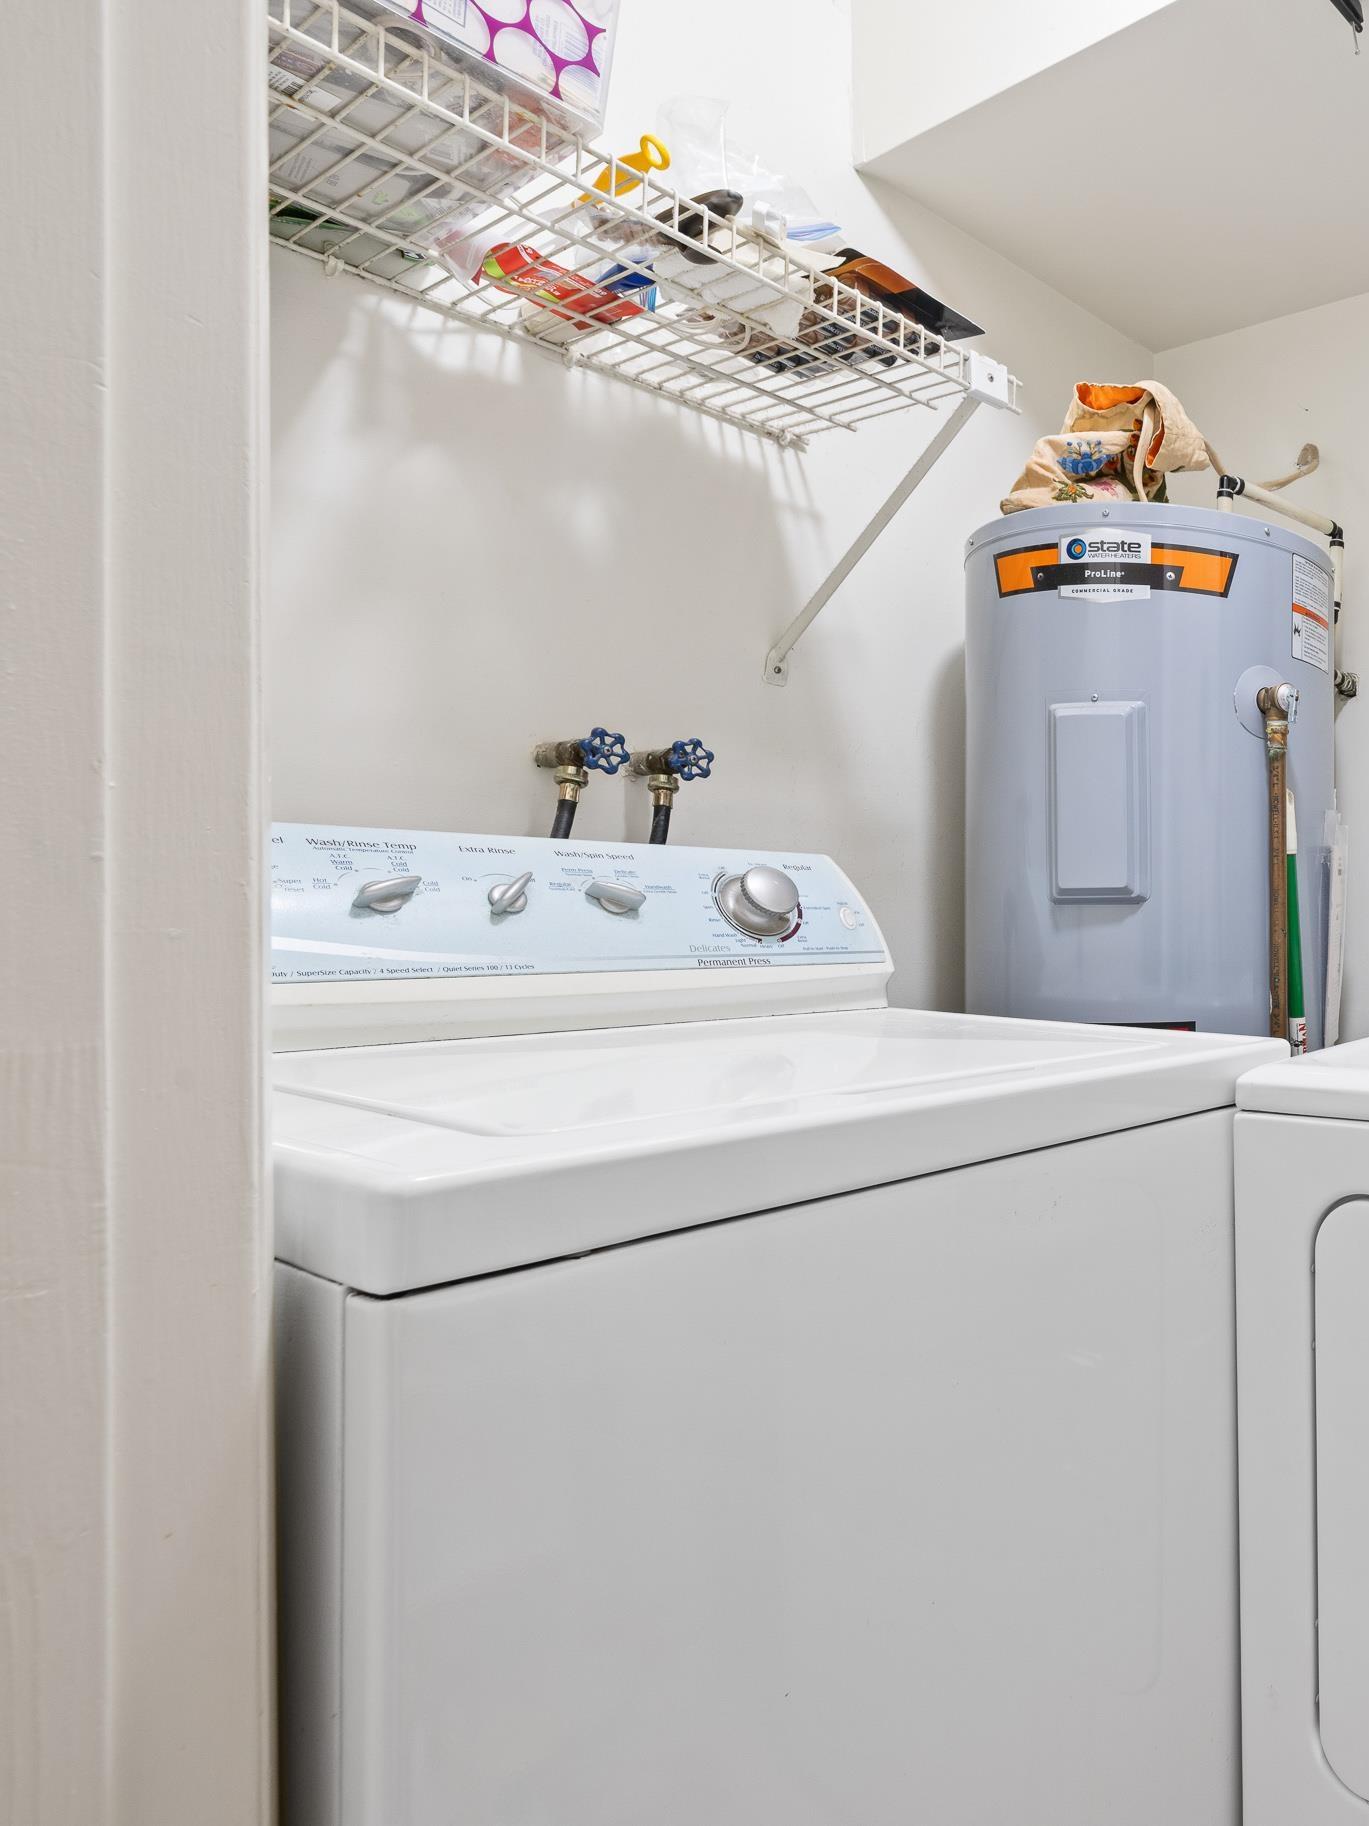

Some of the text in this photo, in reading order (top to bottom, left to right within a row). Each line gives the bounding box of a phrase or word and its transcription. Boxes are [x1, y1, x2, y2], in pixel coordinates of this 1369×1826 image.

[1088, 540, 1141, 553] state
[305, 838, 417, 851] Wash/Rinse Temp
[458, 845, 517, 855] Extra Rinse
[553, 850, 635, 861] Wash/Spin Speed
[782, 863, 813, 872] Regular
[689, 944, 731, 953] Delicates
[697, 956, 771, 967] Permanent Press
[296, 969, 337, 977] SuperSize
[339, 968, 371, 976] Capacity
